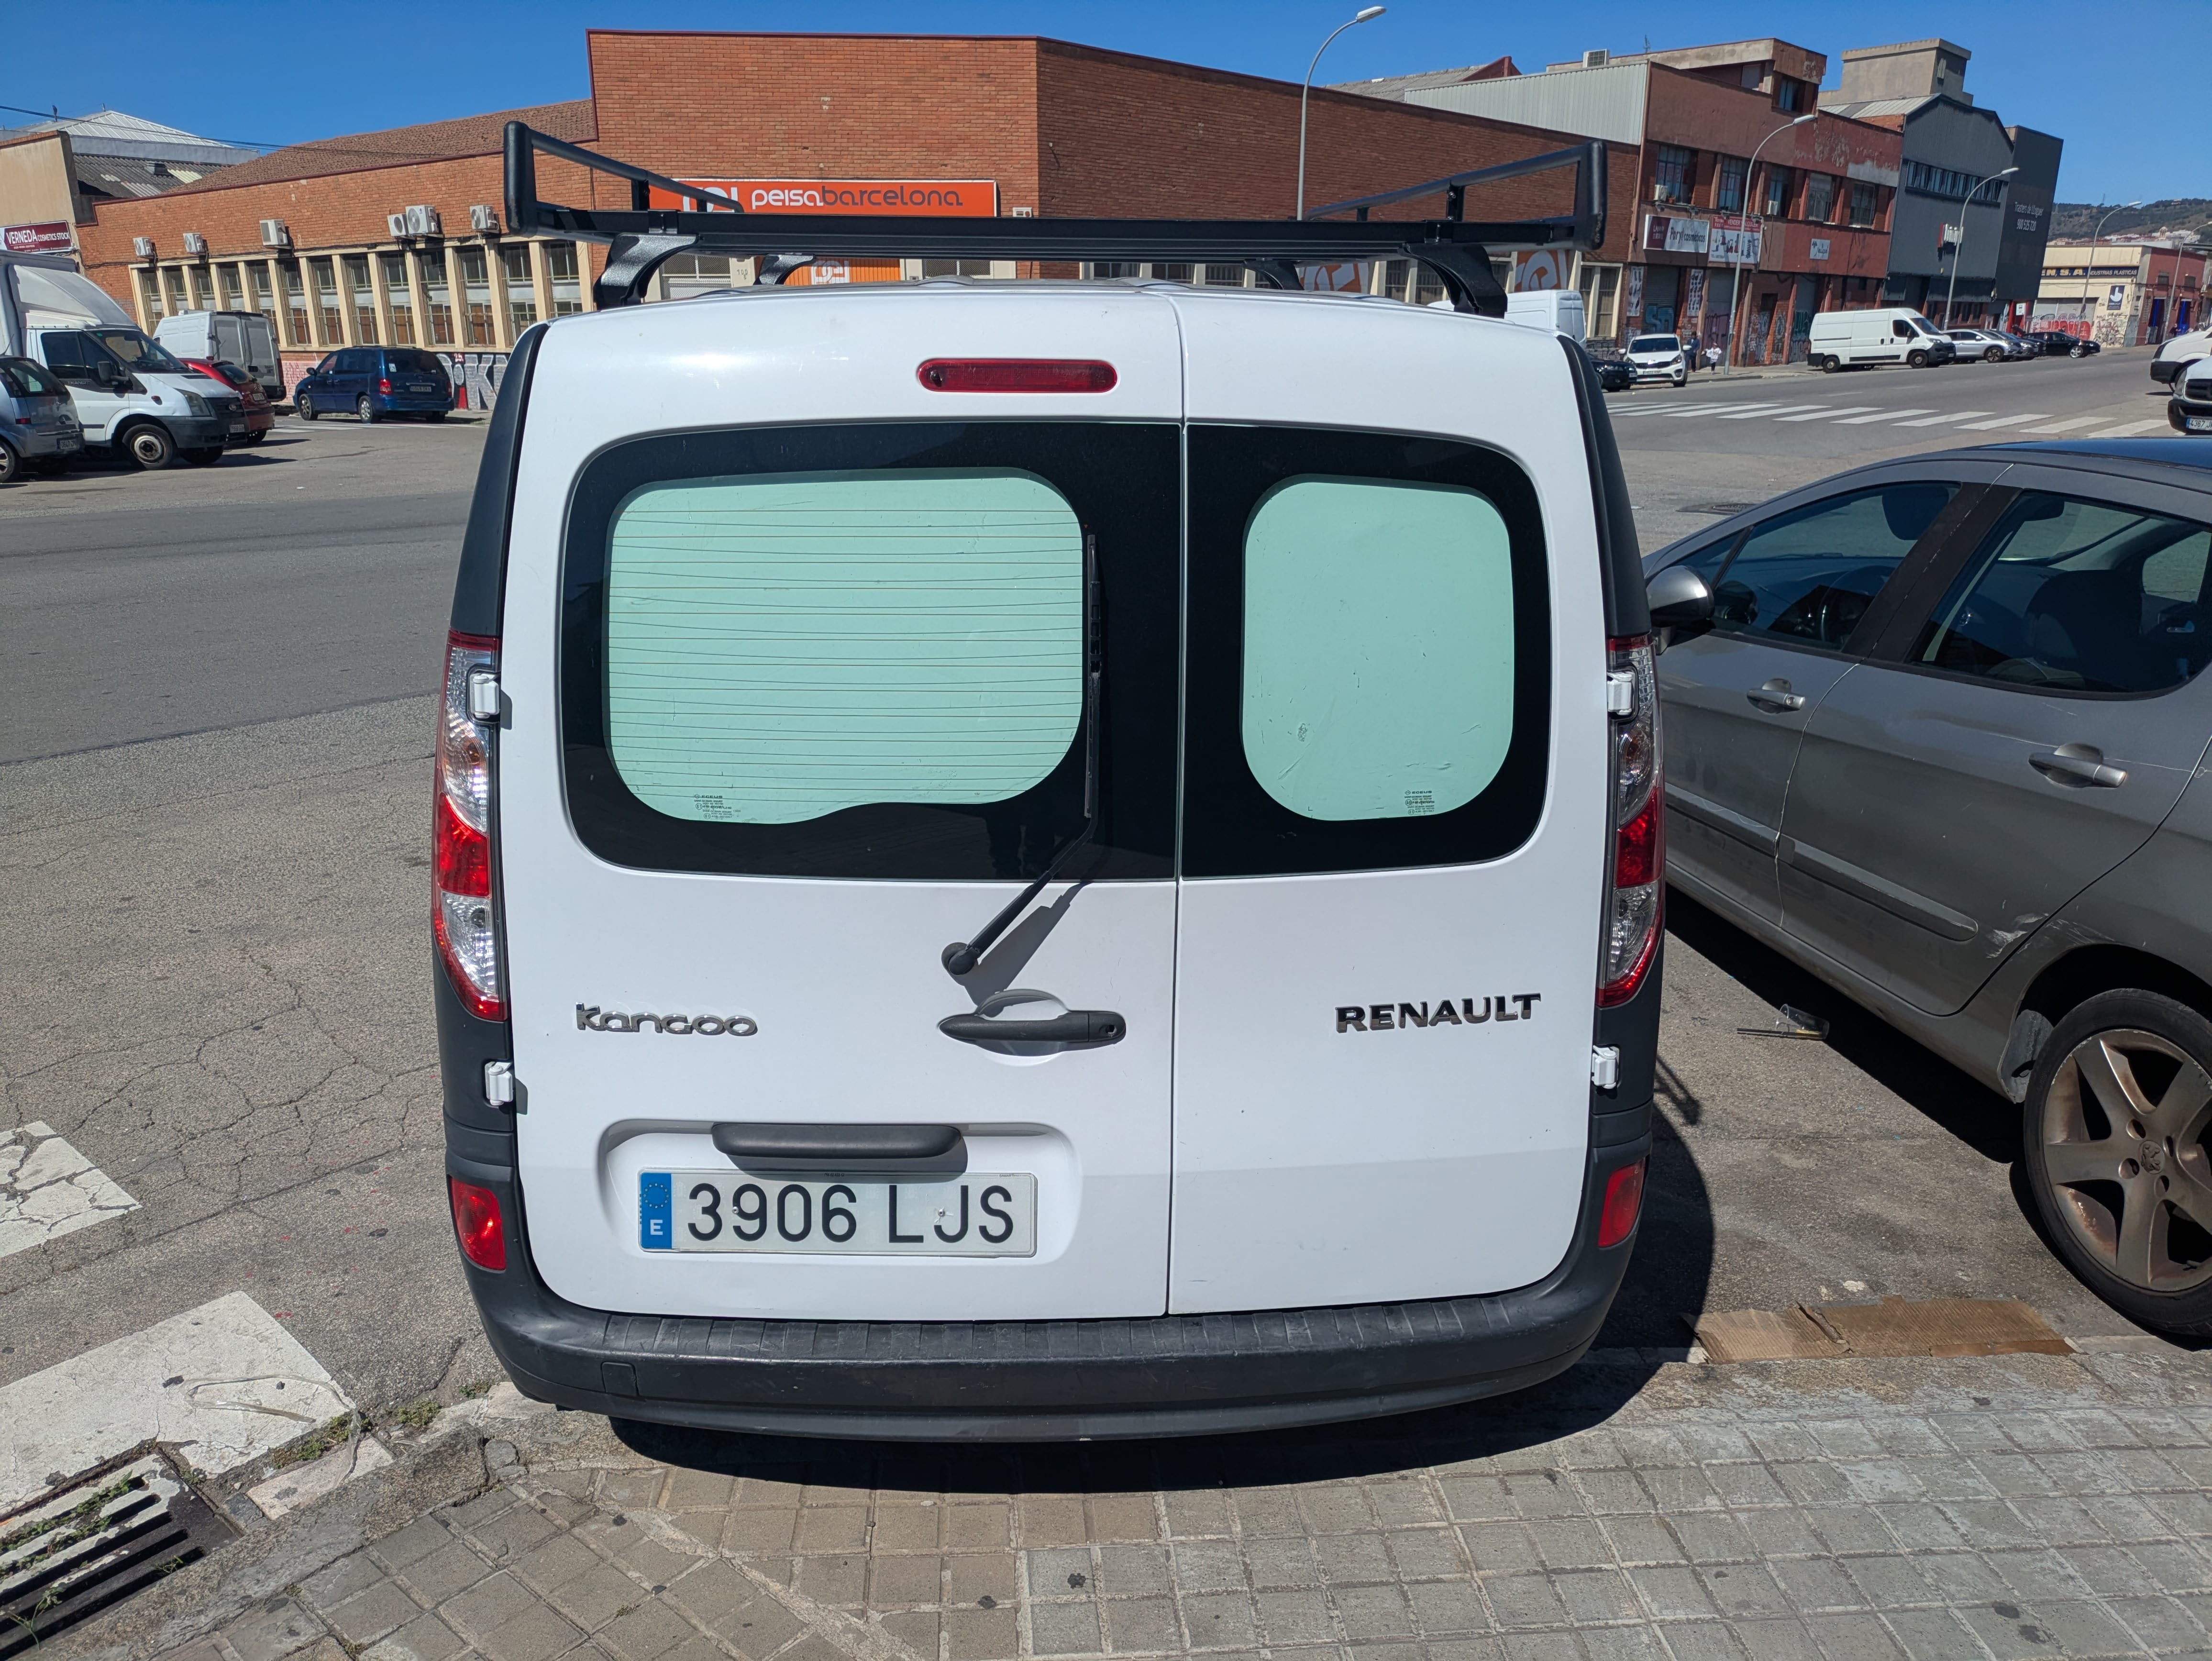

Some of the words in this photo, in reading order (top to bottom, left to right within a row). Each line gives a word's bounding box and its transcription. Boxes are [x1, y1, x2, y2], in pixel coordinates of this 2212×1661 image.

[2014, 201, 2027, 214] Trasters
[6, 229, 38, 244] VERNEDA
[37, 233, 57, 242] COSMETICS
[57, 232, 71, 240] STOCK
[1335, 992, 1541, 1033] RENAULT
[688, 1183, 857, 1243] 3906
[889, 1184, 1014, 1244] LJS
[650, 1219, 663, 1235] E
